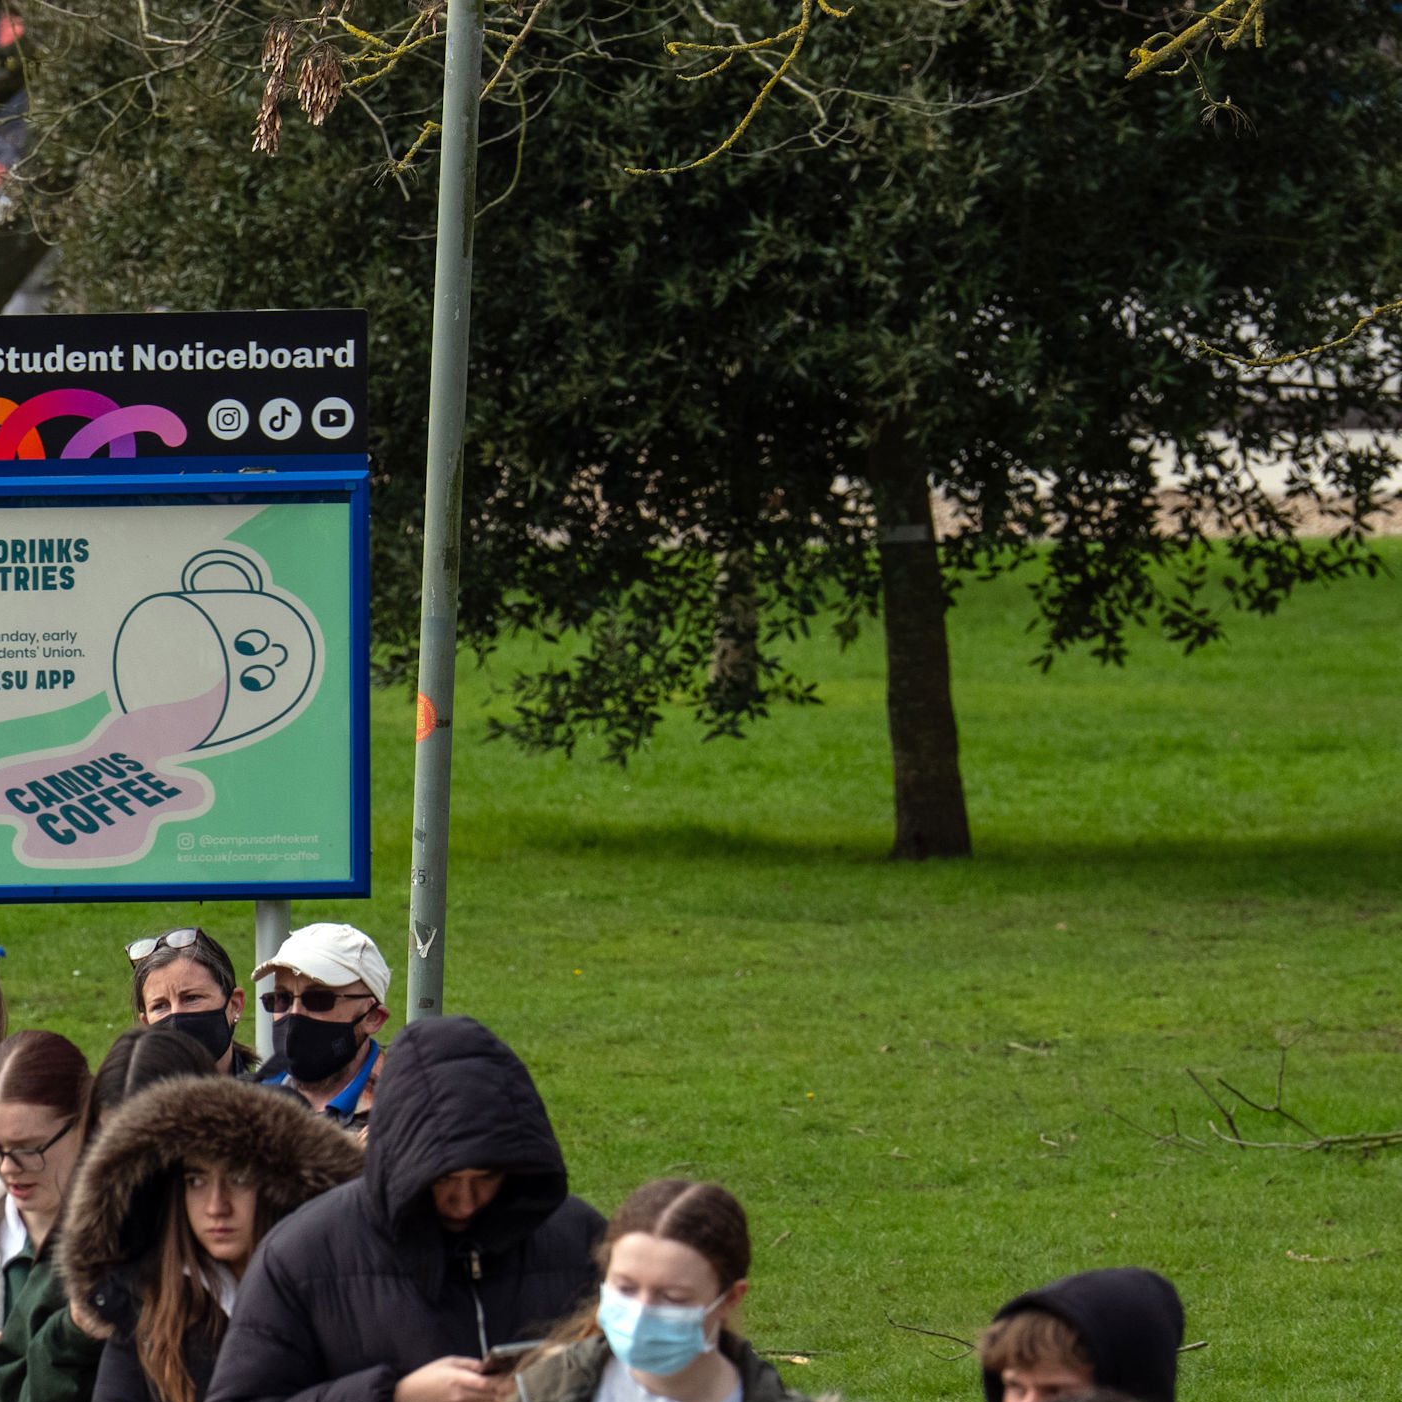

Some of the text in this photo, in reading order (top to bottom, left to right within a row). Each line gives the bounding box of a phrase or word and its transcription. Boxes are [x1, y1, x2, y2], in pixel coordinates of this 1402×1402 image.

[132, 339, 355, 372] Noticeboard
[42, 630, 78, 645] early
[43, 646, 86, 659] Union.
[35, 669, 76, 690] APP
[5, 752, 145, 815] CAMPUS
[36, 771, 183, 846] COFFEE
